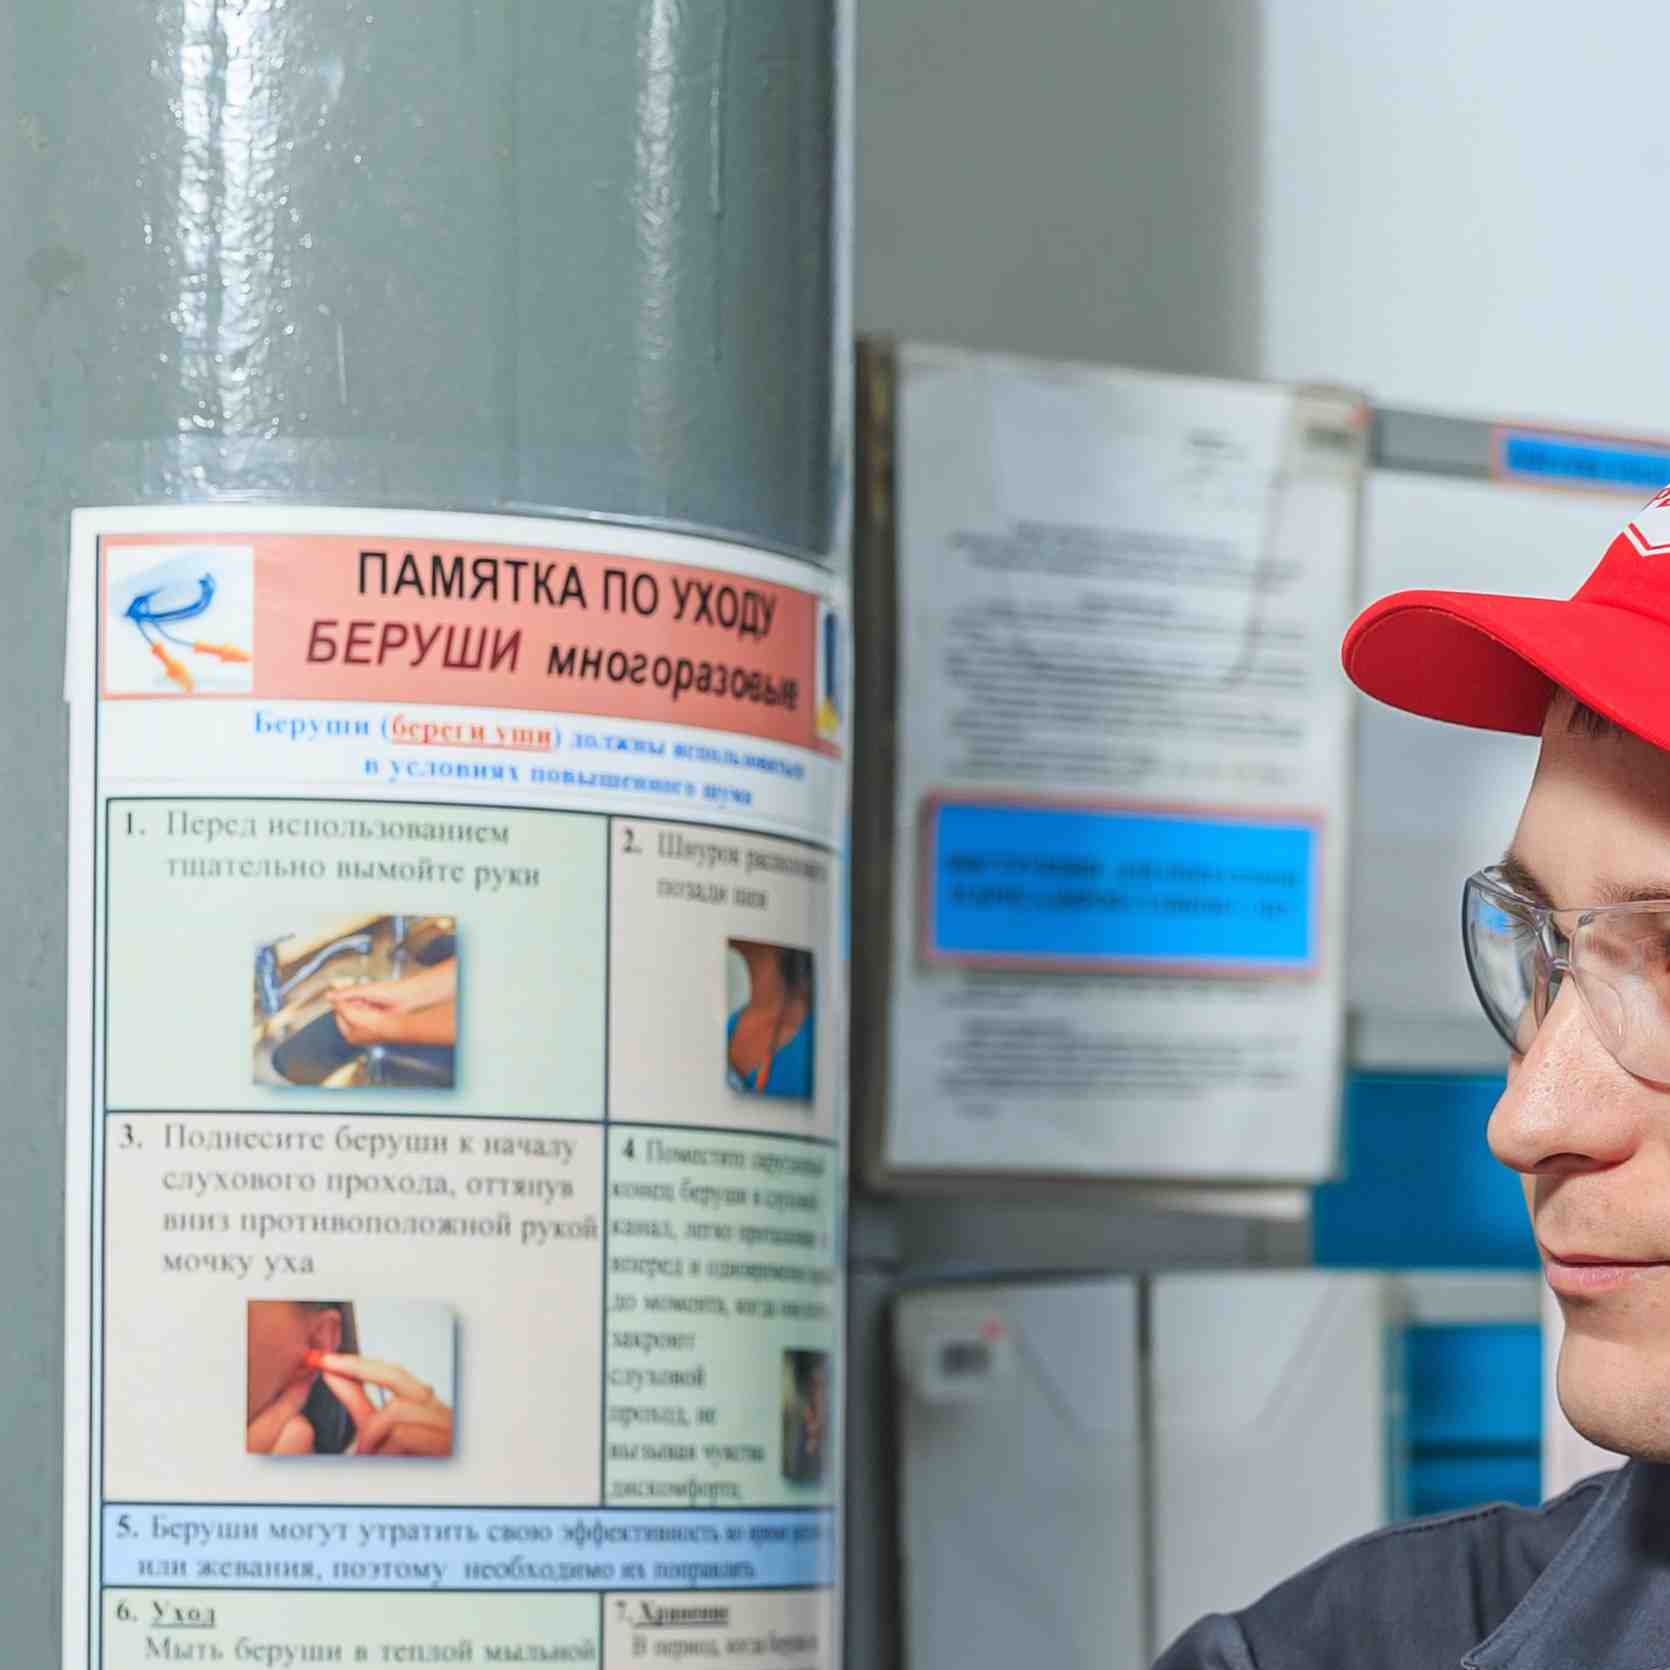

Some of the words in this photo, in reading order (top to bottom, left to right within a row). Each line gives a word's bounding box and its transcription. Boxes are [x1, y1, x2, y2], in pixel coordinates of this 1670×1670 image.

[357, 550, 588, 611] ПАМЯТКА
[601, 573, 659, 617] ПО
[670, 580, 778, 639] УХОДУ
[305, 619, 525, 673] БЕРУШИ
[546, 643, 800, 711] многоразовые
[255, 711, 370, 741] Беруши
[364, 757, 379, 777] в
[388, 757, 520, 783] условиях
[125, 811, 146, 836] 1.
[167, 810, 258, 841] Перед
[268, 818, 510, 845] использованием
[623, 828, 642, 854] 2.
[166, 856, 326, 880] тщательно
[337, 858, 466, 885] вымойте
[473, 864, 541, 892] руки
[119, 1124, 143, 1150] 3.
[163, 1123, 325, 1154] Поднесите
[334, 1125, 450, 1160] беруши
[459, 1135, 474, 1154] к
[483, 1136, 577, 1162] началу
[161, 1173, 316, 1199] слухового
[326, 1173, 456, 1200] прохода,
[466, 1177, 575, 1202] оттянув
[162, 1212, 231, 1232] вниз
[240, 1209, 512, 1241] противоположной
[519, 1216, 599, 1245] рукой
[162, 1253, 255, 1278] мочку
[264, 1255, 315, 1278] уха
[115, 1513, 139, 1540] 5.
[152, 1513, 260, 1548] Беруши
[267, 1521, 349, 1547] могут
[358, 1521, 481, 1548] утратить
[486, 1522, 553, 1542] свою
[137, 1557, 188, 1577] или
[196, 1557, 323, 1582] жевания,
[332, 1560, 448, 1587] поэтому
[464, 1554, 615, 1583] необходимо
[114, 1600, 138, 1623] 6.
[150, 1599, 217, 1627] Уход
[144, 1636, 225, 1662] Мыть
[235, 1636, 344, 1669] беруши
[353, 1645, 369, 1662] в
[379, 1639, 474, 1665] теплой
[484, 1639, 597, 1665] мыльной
